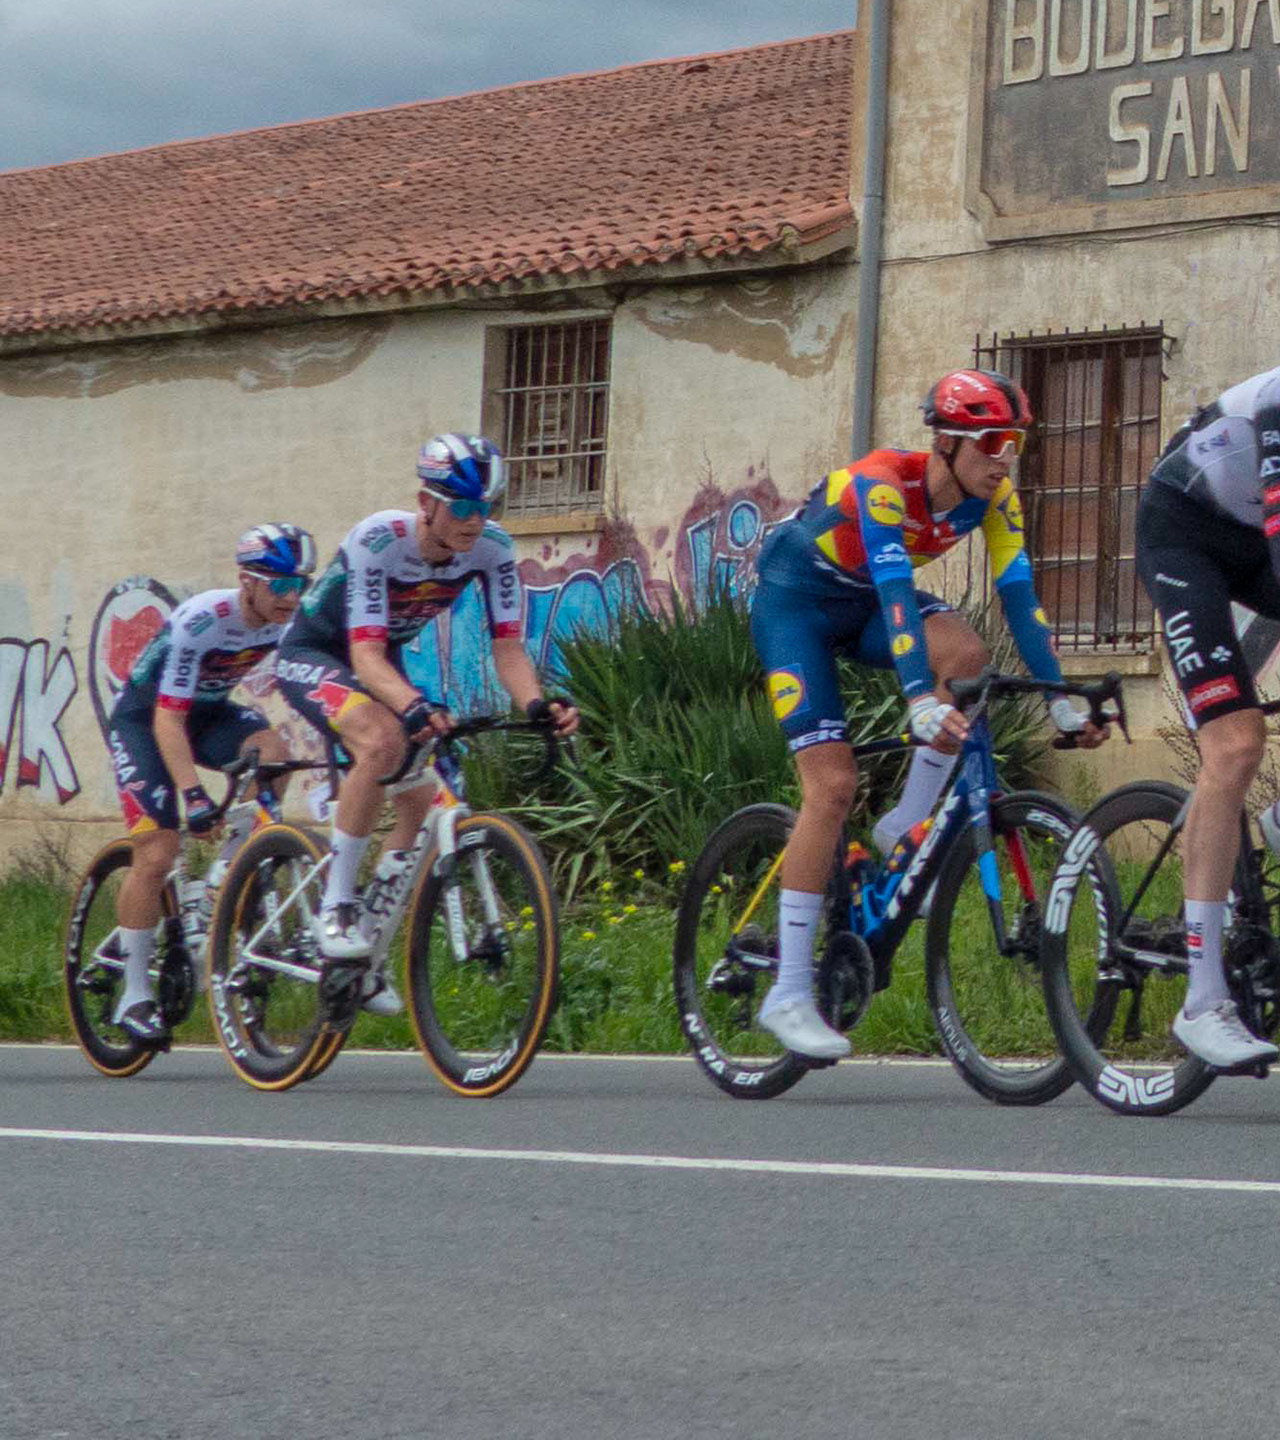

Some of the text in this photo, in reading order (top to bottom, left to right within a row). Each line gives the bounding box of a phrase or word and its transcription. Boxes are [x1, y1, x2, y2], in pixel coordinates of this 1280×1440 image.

[1106, 67, 1249, 187] SAN
[276, 658, 325, 686] BORA
[1165, 610, 1204, 678] UAE
